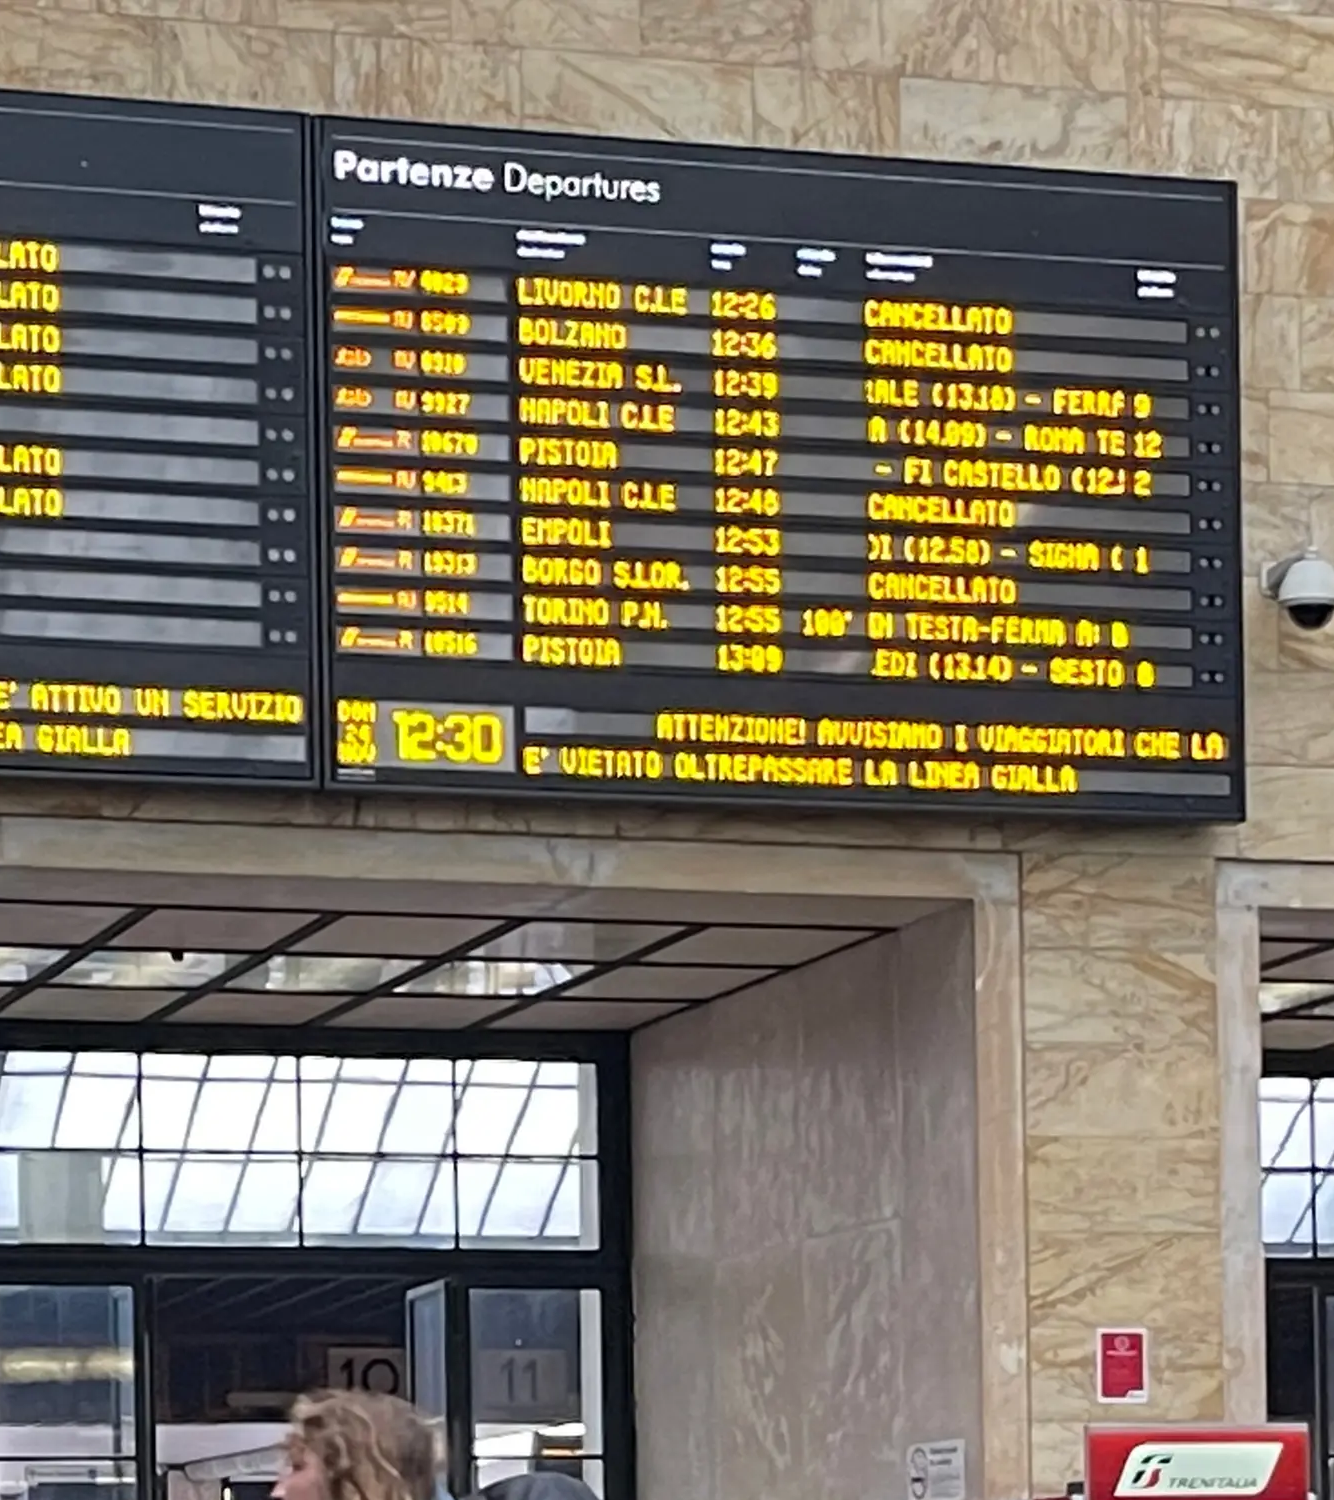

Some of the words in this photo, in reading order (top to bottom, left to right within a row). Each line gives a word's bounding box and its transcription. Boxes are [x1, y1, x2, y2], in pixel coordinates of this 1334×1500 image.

[333, 150, 495, 193] Partenze
[503, 163, 661, 204] Departures
[518, 278, 623, 309] LIVORNO
[635, 285, 688, 315] C.LE
[713, 291, 777, 320] 12:26
[866, 300, 1013, 334] CANCELLATO
[520, 317, 629, 349] BOLZANO
[713, 329, 779, 359] 12:36
[866, 339, 1015, 372] CANCELLATO
[520, 358, 623, 388] VENEZIA
[637, 365, 678, 392] S.L.
[715, 370, 779, 399] 12:39
[1135, 394, 1151, 418] 9
[520, 397, 610, 428] NAPOLI
[621, 402, 675, 432] C.LE
[716, 409, 779, 437] 12:43
[1026, 425, 1085, 454] ROMA
[1098, 429, 1125, 456] TE
[1135, 431, 1162, 458] 12
[520, 437, 619, 468] PISTOIA
[716, 449, 778, 476] 12:47
[905, 456, 932, 486] FI
[939, 460, 1061, 491] CASTELLO
[1135, 470, 1151, 496] 2
[521, 477, 611, 507] NAPOLI
[622, 482, 676, 511] C.LE
[716, 488, 781, 516] 12:48
[869, 493, 1019, 527] CANCELLATO
[523, 517, 612, 548] EMPOLI
[716, 526, 781, 556] 12:53
[524, 555, 601, 585] BORGO
[717, 565, 782, 594] 12:55
[869, 572, 1016, 604] CANCELLATO
[524, 595, 610, 625] TORINO
[717, 605, 782, 633] 12:55
[902, 613, 1067, 646] TESTA-FERMA
[524, 634, 622, 665] PISTOIA
[719, 644, 783, 672] 13:09
[1051, 657, 1125, 687] SESTO
[31, 684, 124, 714] ATTIVO
[131, 689, 172, 716] UN
[181, 690, 303, 723] SERVIZIO
[33, 725, 132, 756] GIALLA
[392, 709, 503, 763] 12:30
[658, 714, 806, 745] ATTENZIONE!
[818, 718, 943, 749] AVVISIAMO
[957, 725, 968, 752] I
[978, 725, 1125, 756] VIAGGIATORI
[1135, 732, 1181, 759] CHE
[1192, 733, 1226, 759] LA
[524, 747, 548, 774] E'
[560, 747, 663, 778] VIETATO
[676, 752, 853, 785] OLTREPASSARE
[866, 759, 899, 785] LA
[909, 761, 980, 788] LINEA
[987, 765, 1078, 792] GIALLA
[340, 1357, 400, 1397] 10
[499, 1357, 540, 1402] 11
[1168, 1476, 1258, 1490] TRENITALIA
